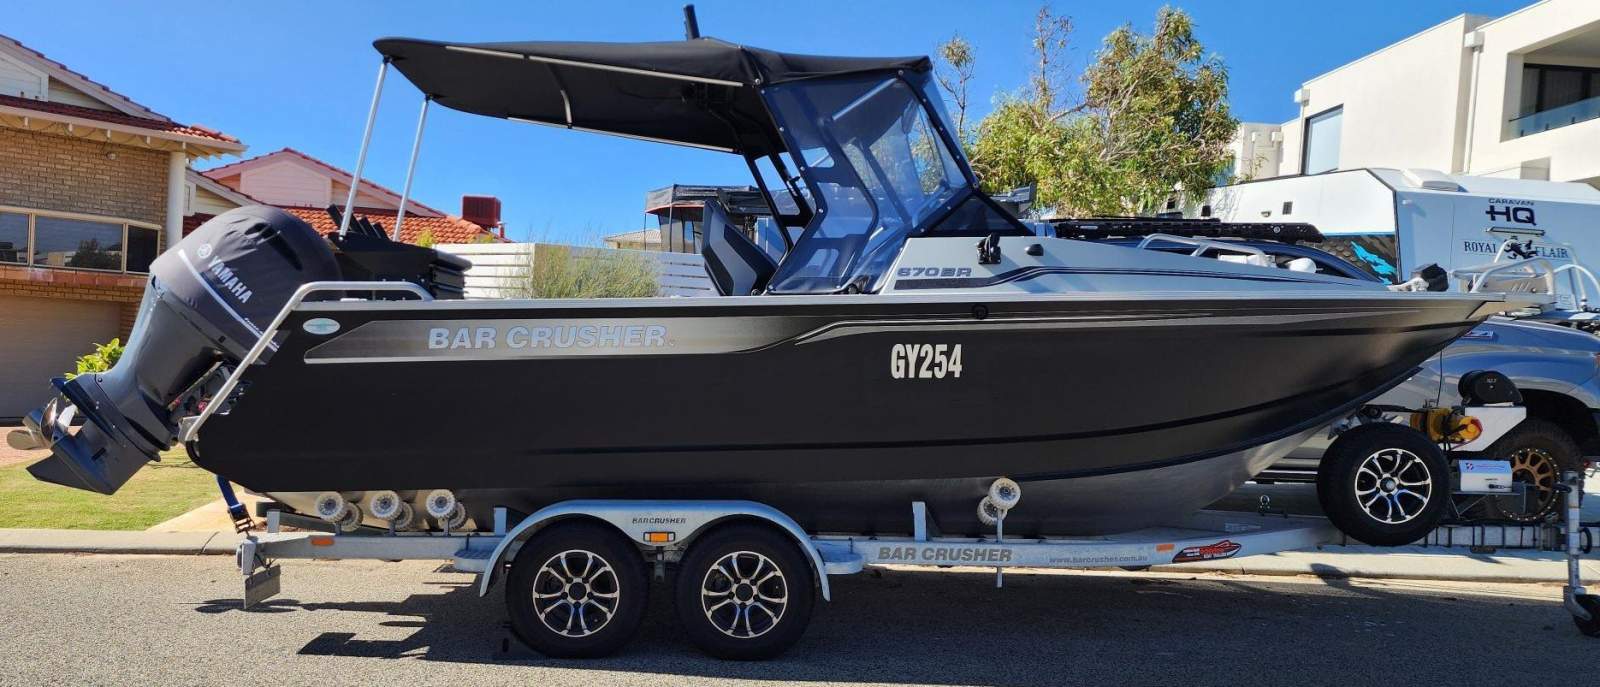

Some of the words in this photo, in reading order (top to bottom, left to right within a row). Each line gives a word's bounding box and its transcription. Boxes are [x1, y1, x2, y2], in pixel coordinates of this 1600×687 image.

[1485, 205, 1536, 225] HQ
[1535, 246, 1569, 258] FLAIR
[207, 255, 253, 304] YAMAHA
[428, 327, 498, 350] BAR
[506, 325, 668, 349] CRUSHER
[891, 344, 962, 378] GY254
[878, 547, 917, 561] BAR
[921, 547, 1013, 562] CRUSHER
